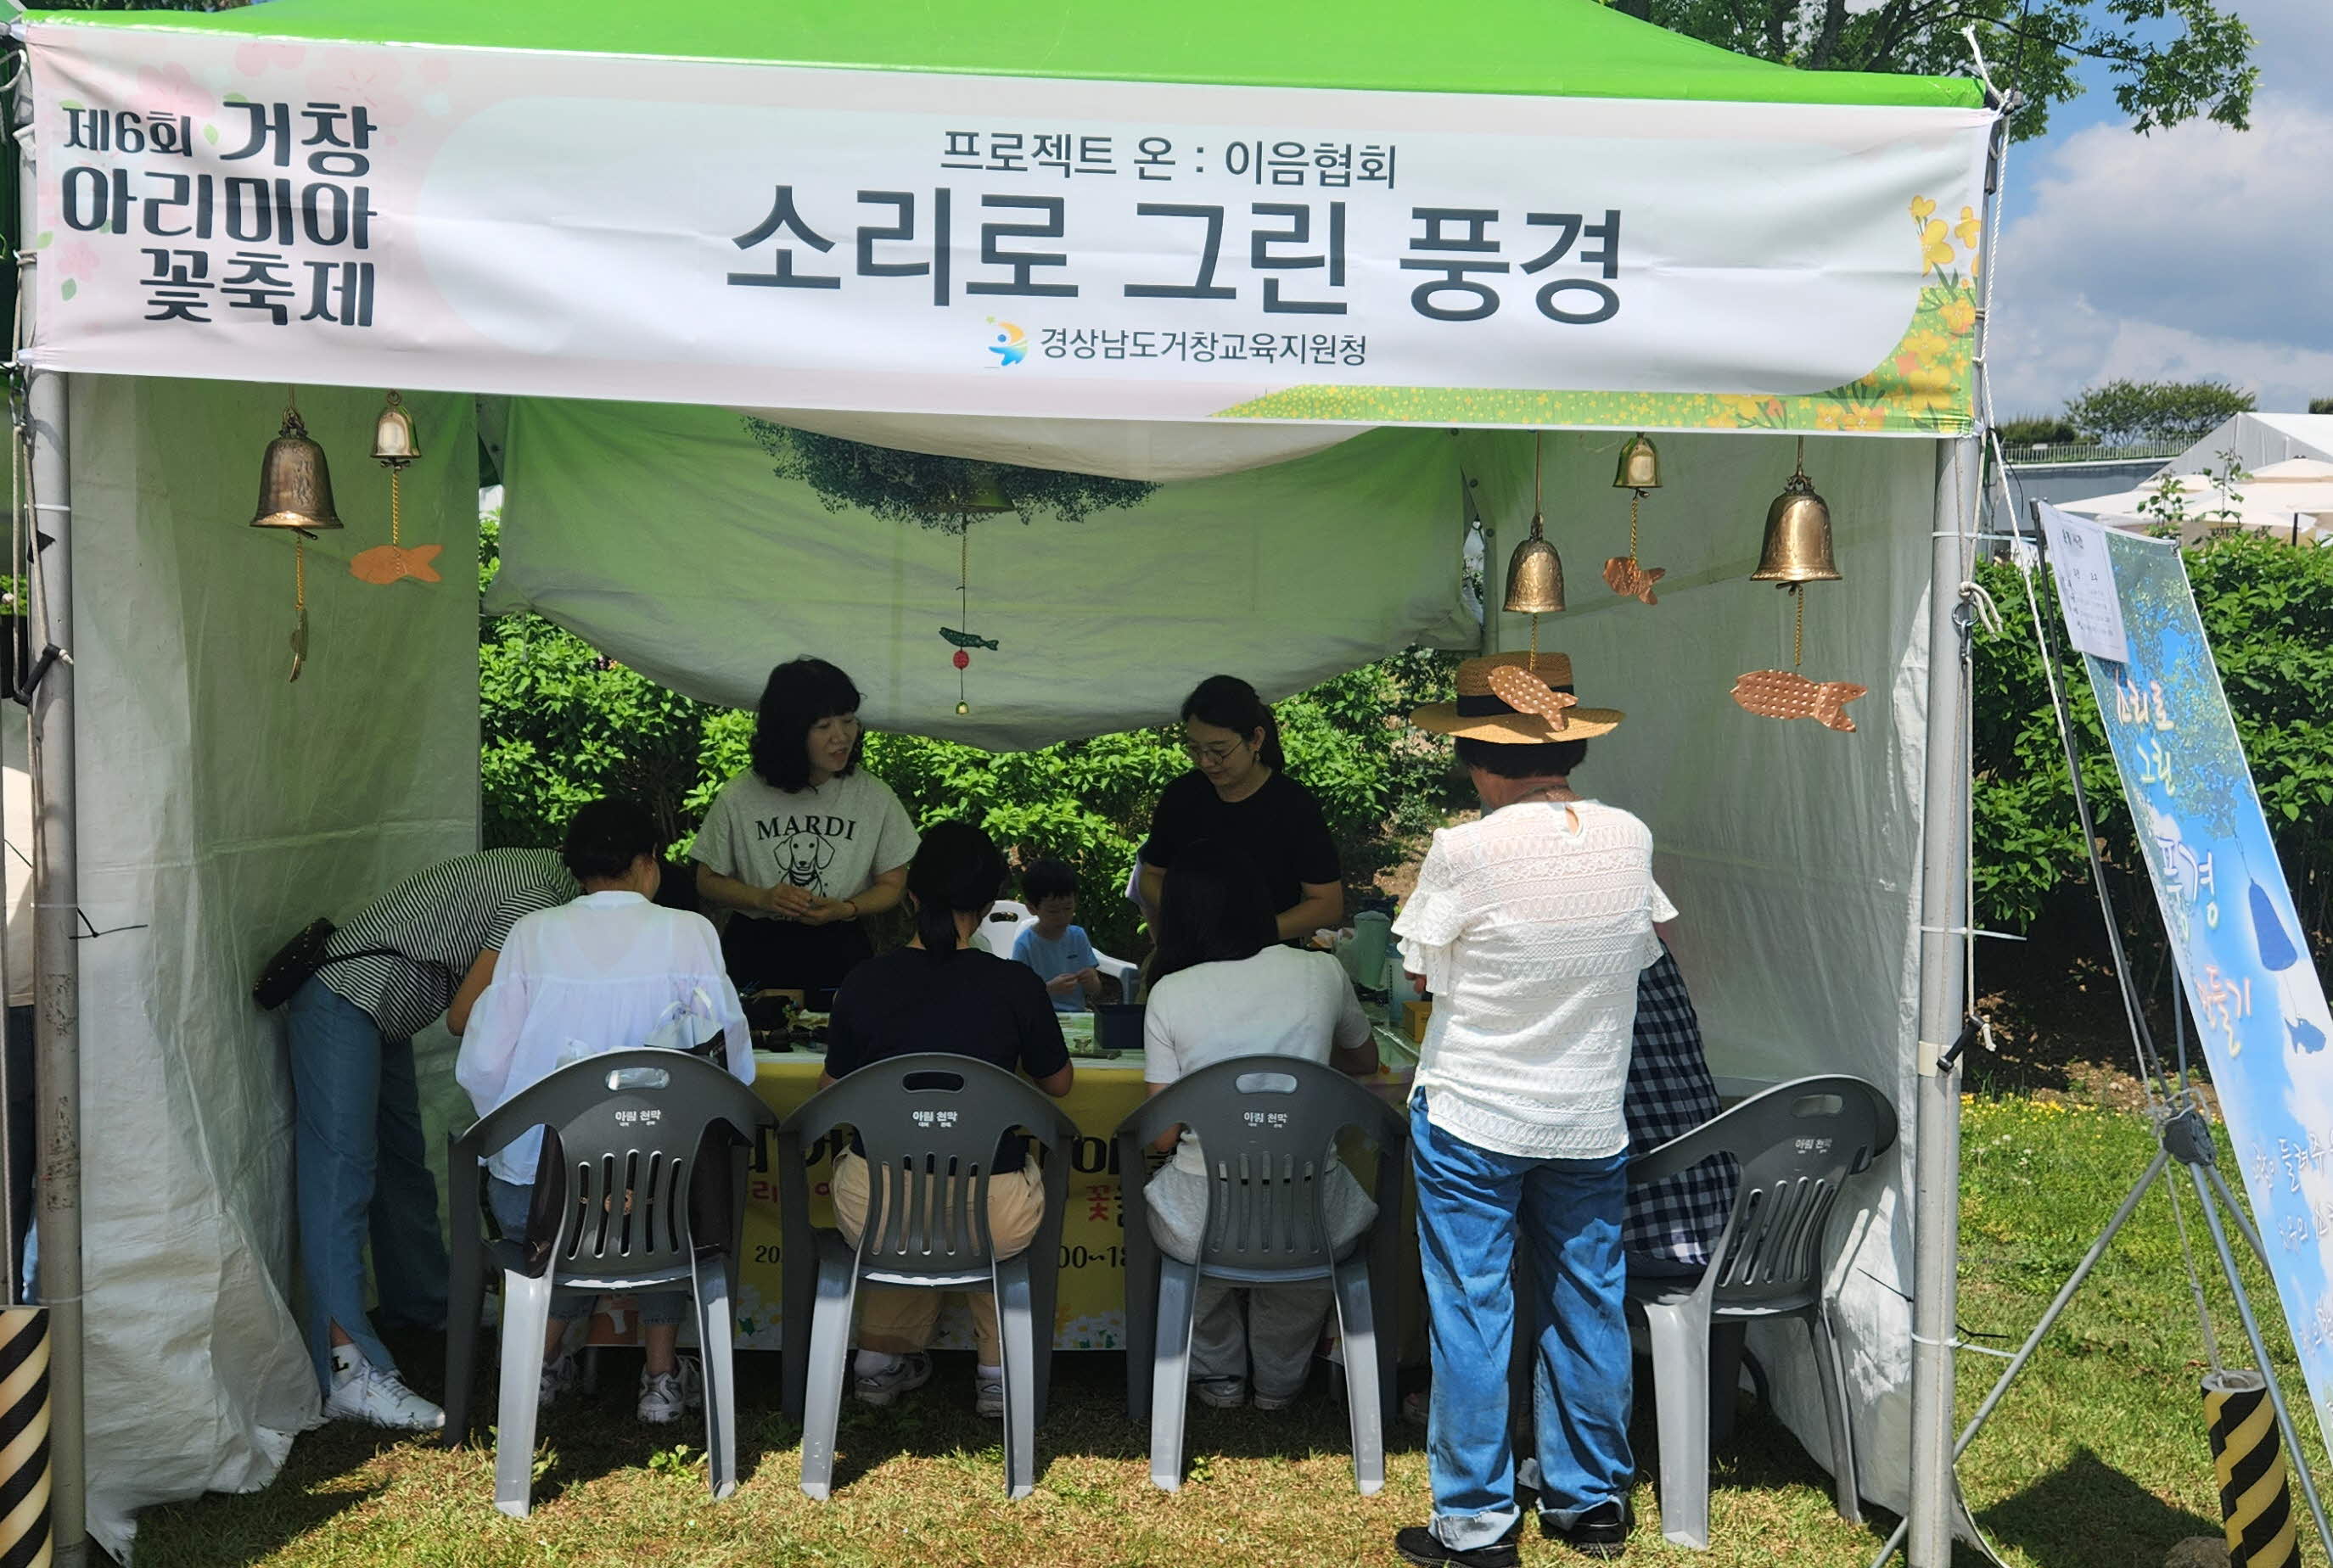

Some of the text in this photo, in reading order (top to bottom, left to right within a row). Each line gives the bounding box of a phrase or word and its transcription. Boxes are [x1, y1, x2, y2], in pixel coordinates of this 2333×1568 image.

[63, 101, 379, 176] 제6회 거창
[940, 131, 1397, 190] 프로젝트 온 : 이음협회
[62, 166, 379, 249] 아리미아
[139, 248, 376, 328] 꽃축제
[726, 183, 1622, 324] 소리로 그린 풍경
[1040, 328, 1367, 367] 경상남도거창교육지원청
[755, 815, 856, 841] MARDI
[2156, 835, 2218, 941] 풍경
